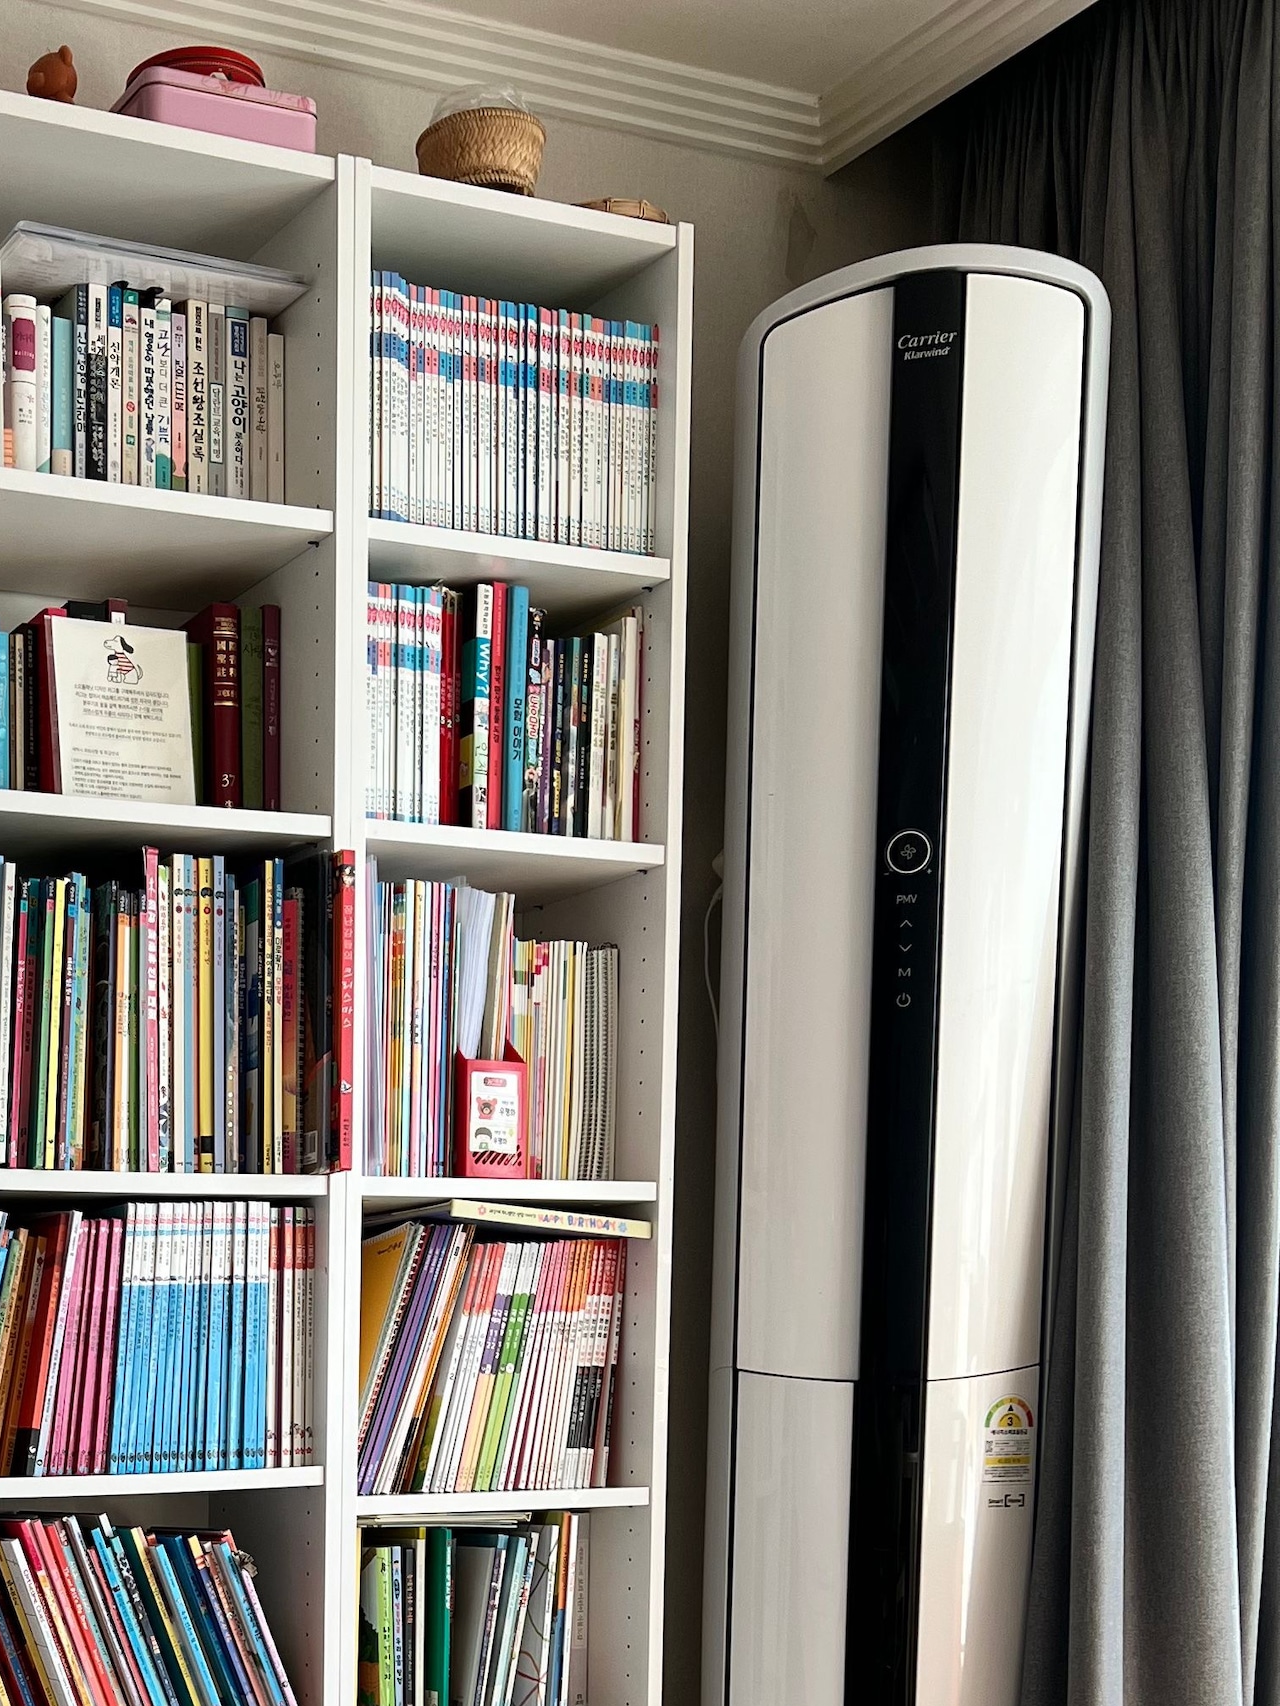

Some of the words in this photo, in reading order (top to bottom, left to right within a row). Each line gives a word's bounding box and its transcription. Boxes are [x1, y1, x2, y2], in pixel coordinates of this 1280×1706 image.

[897, 331, 958, 349] Carrier
[192, 360, 206, 463] 조선왕조실록
[476, 643, 491, 697] Why?
[896, 894, 917, 904] PMV
[342, 904, 354, 960] 장난감들의
[341, 966, 353, 1028] 크리스마스
[538, 1210, 564, 1224] HAPPY
[567, 1214, 617, 1232] BIRTHDAY
